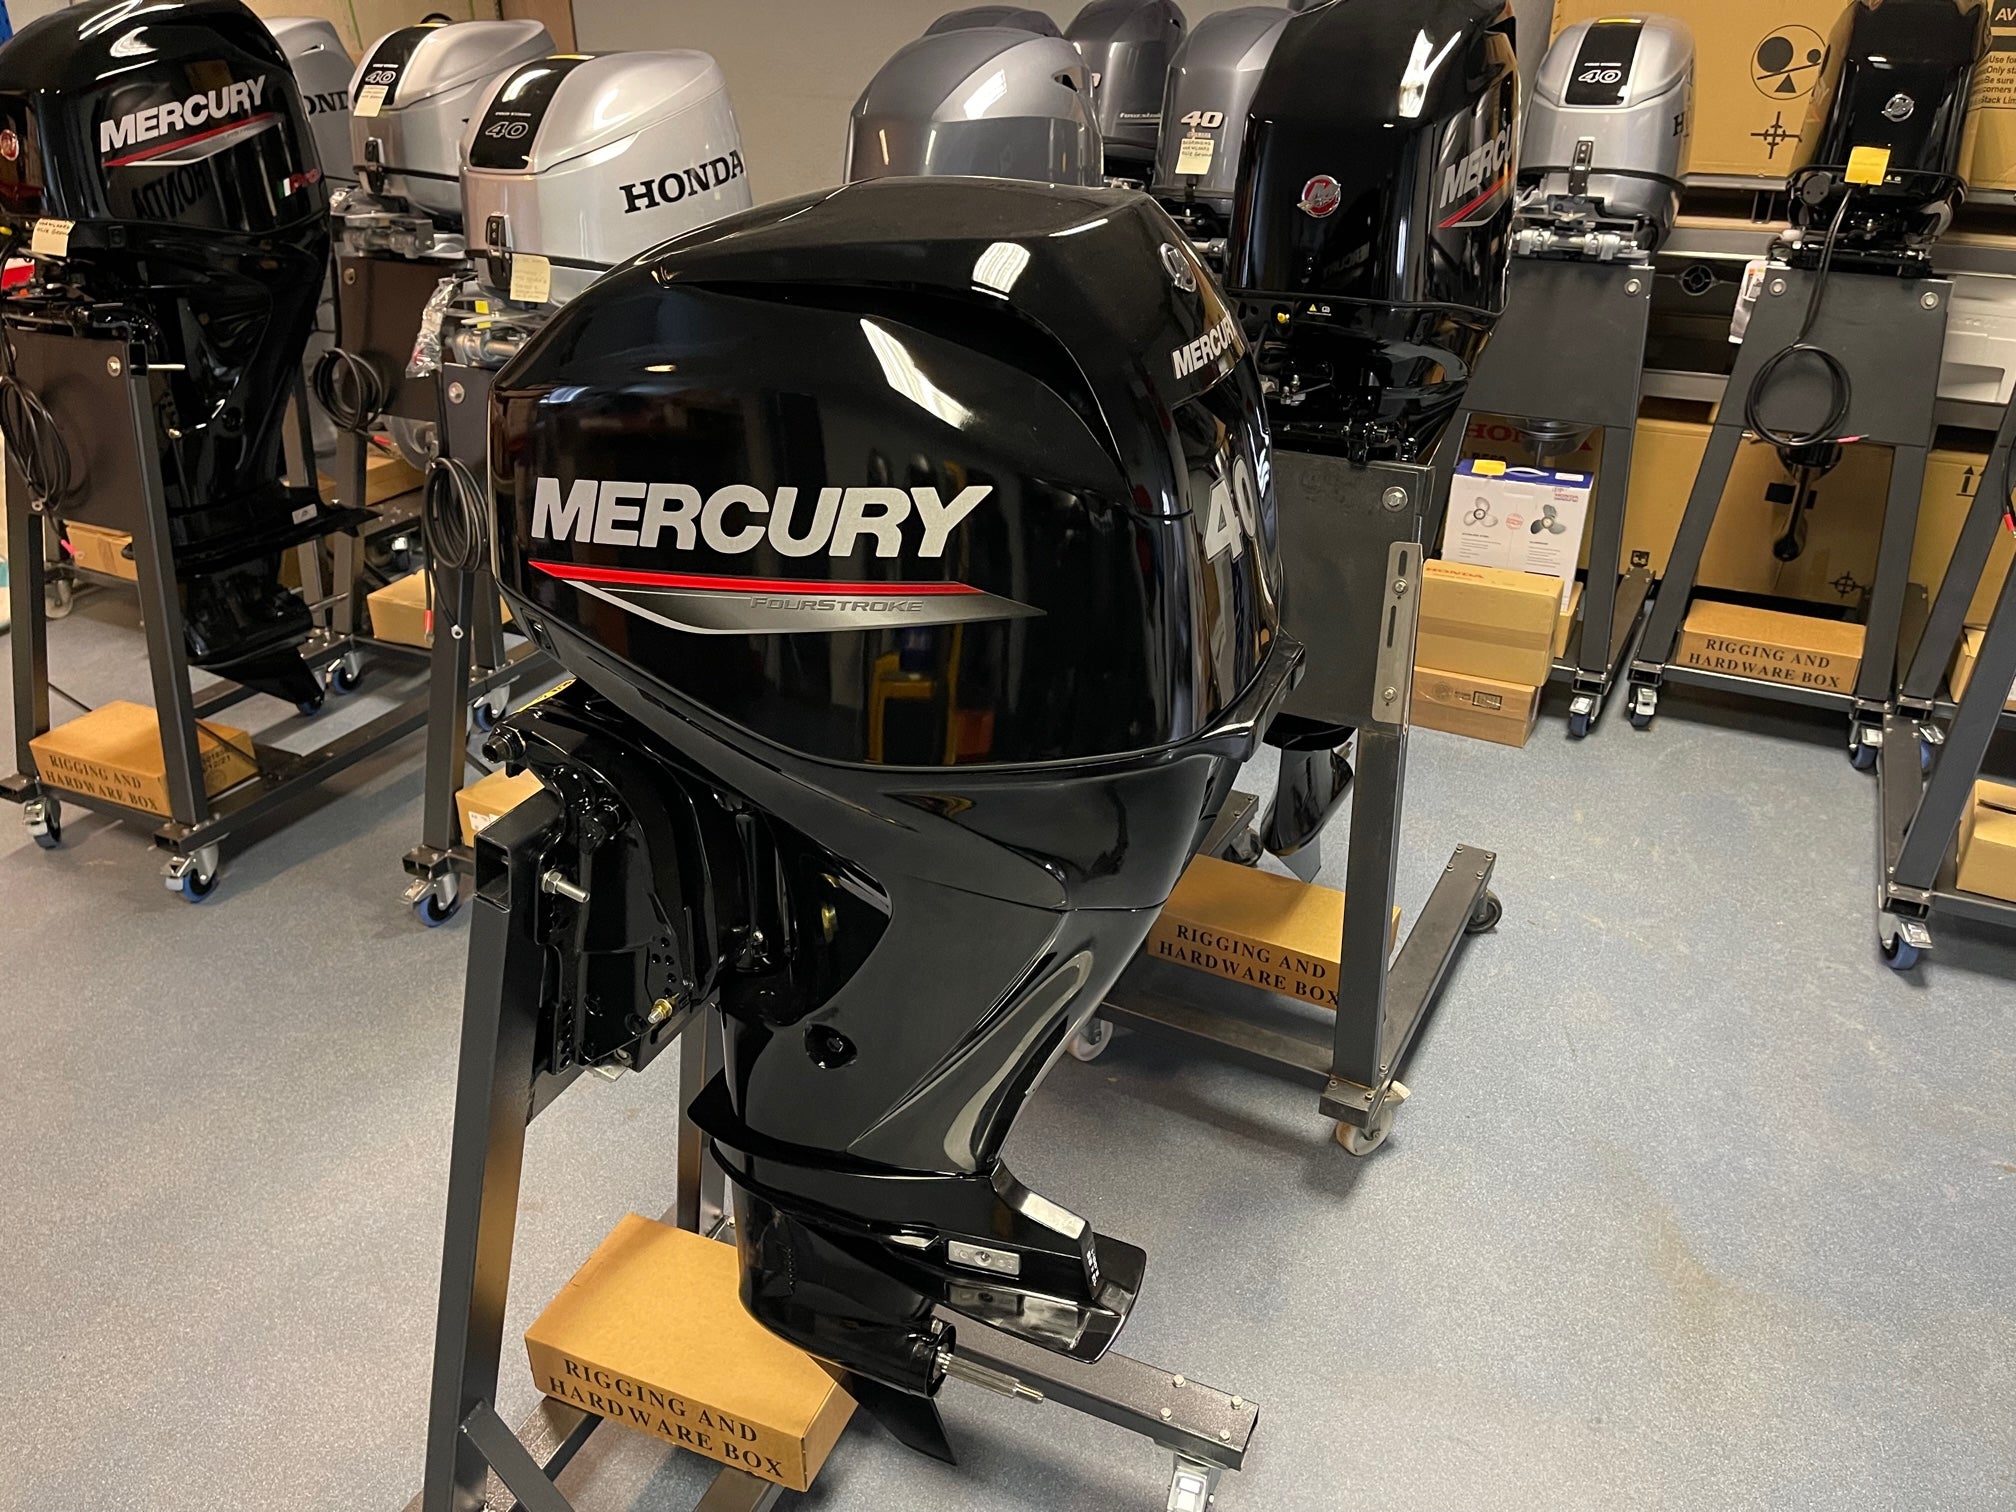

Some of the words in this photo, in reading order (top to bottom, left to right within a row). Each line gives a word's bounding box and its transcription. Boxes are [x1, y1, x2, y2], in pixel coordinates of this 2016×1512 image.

[365, 70, 397, 84] 40
[1578, 69, 1622, 84] 40
[1987, 66, 2005, 76] Only
[100, 75, 266, 153] MERCURY
[485, 121, 529, 139] 40
[1180, 110, 1224, 128] 40
[619, 149, 745, 214] HONDA
[1440, 123, 1512, 209] MERCU
[1171, 315, 1237, 380] MERCUR
[531, 477, 993, 558] MERCURY
[1201, 454, 1257, 564] 40
[1688, 653, 1796, 681] HARDWARE
[1801, 672, 1841, 688] BOX
[1705, 638, 1786, 662] RIGGING
[1790, 652, 1831, 669] AND
[45, 770, 126, 803] HARDWARE
[128, 793, 158, 811] BOX
[49, 755, 109, 781] RIGGING
[113, 773, 142, 789] AND
[1159, 940, 1287, 990] HARDWARE
[1295, 980, 1339, 1006] BOX
[1177, 924, 1271, 963] RIGGING
[1279, 955, 1326, 979] AND
[549, 1376, 713, 1451] HARDWARE
[723, 1440, 784, 1479] BOX
[563, 1358, 687, 1417] RIGGING
[698, 1409, 758, 1442] AND
